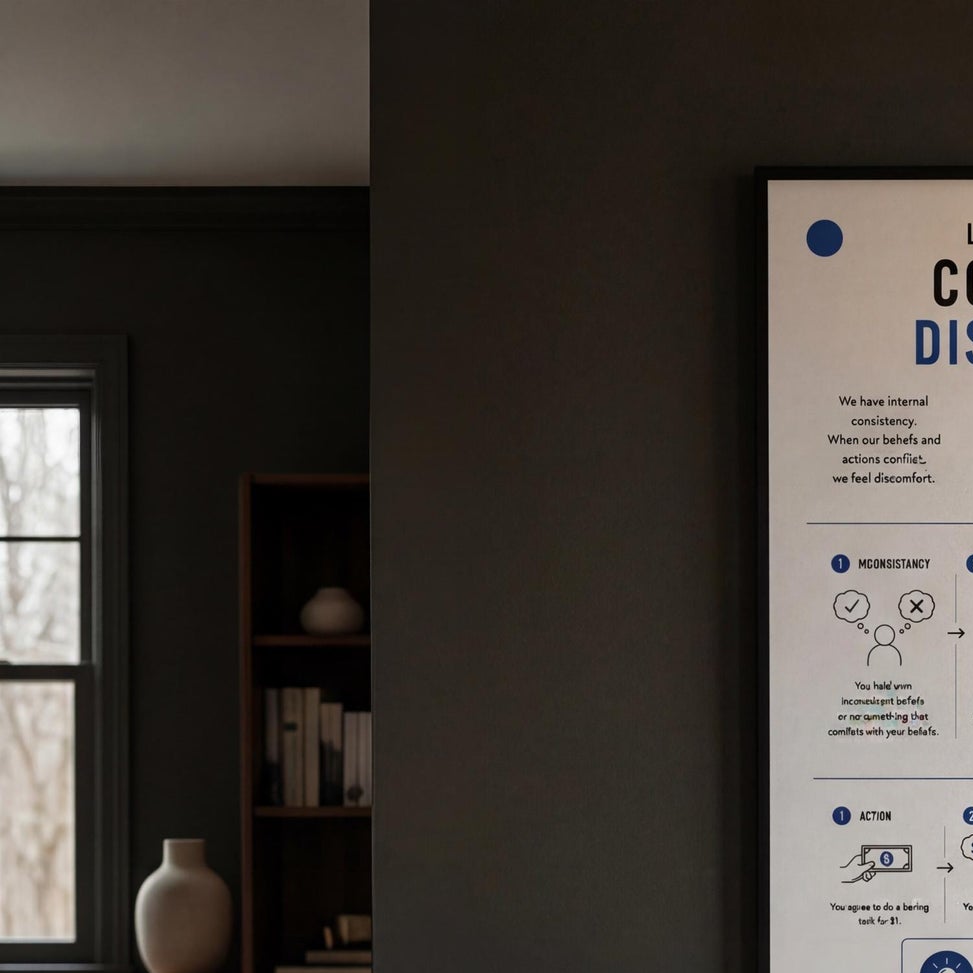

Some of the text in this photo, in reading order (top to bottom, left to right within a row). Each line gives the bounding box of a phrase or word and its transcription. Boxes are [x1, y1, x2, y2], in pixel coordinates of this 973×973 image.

[839, 395, 929, 407] We have internal
[851, 416, 917, 429] consistency.
[828, 434, 859, 445] When
[862, 437, 880, 445] our
[921, 434, 941, 445] and
[842, 454, 881, 464] actions
[833, 472, 935, 484] we feel discomfort.
[855, 681, 871, 690] You
[865, 727, 884, 736] with
[859, 811, 892, 822] ACTION
[830, 902, 846, 911] You
[873, 903, 881, 911] to
[883, 902, 894, 911] do
